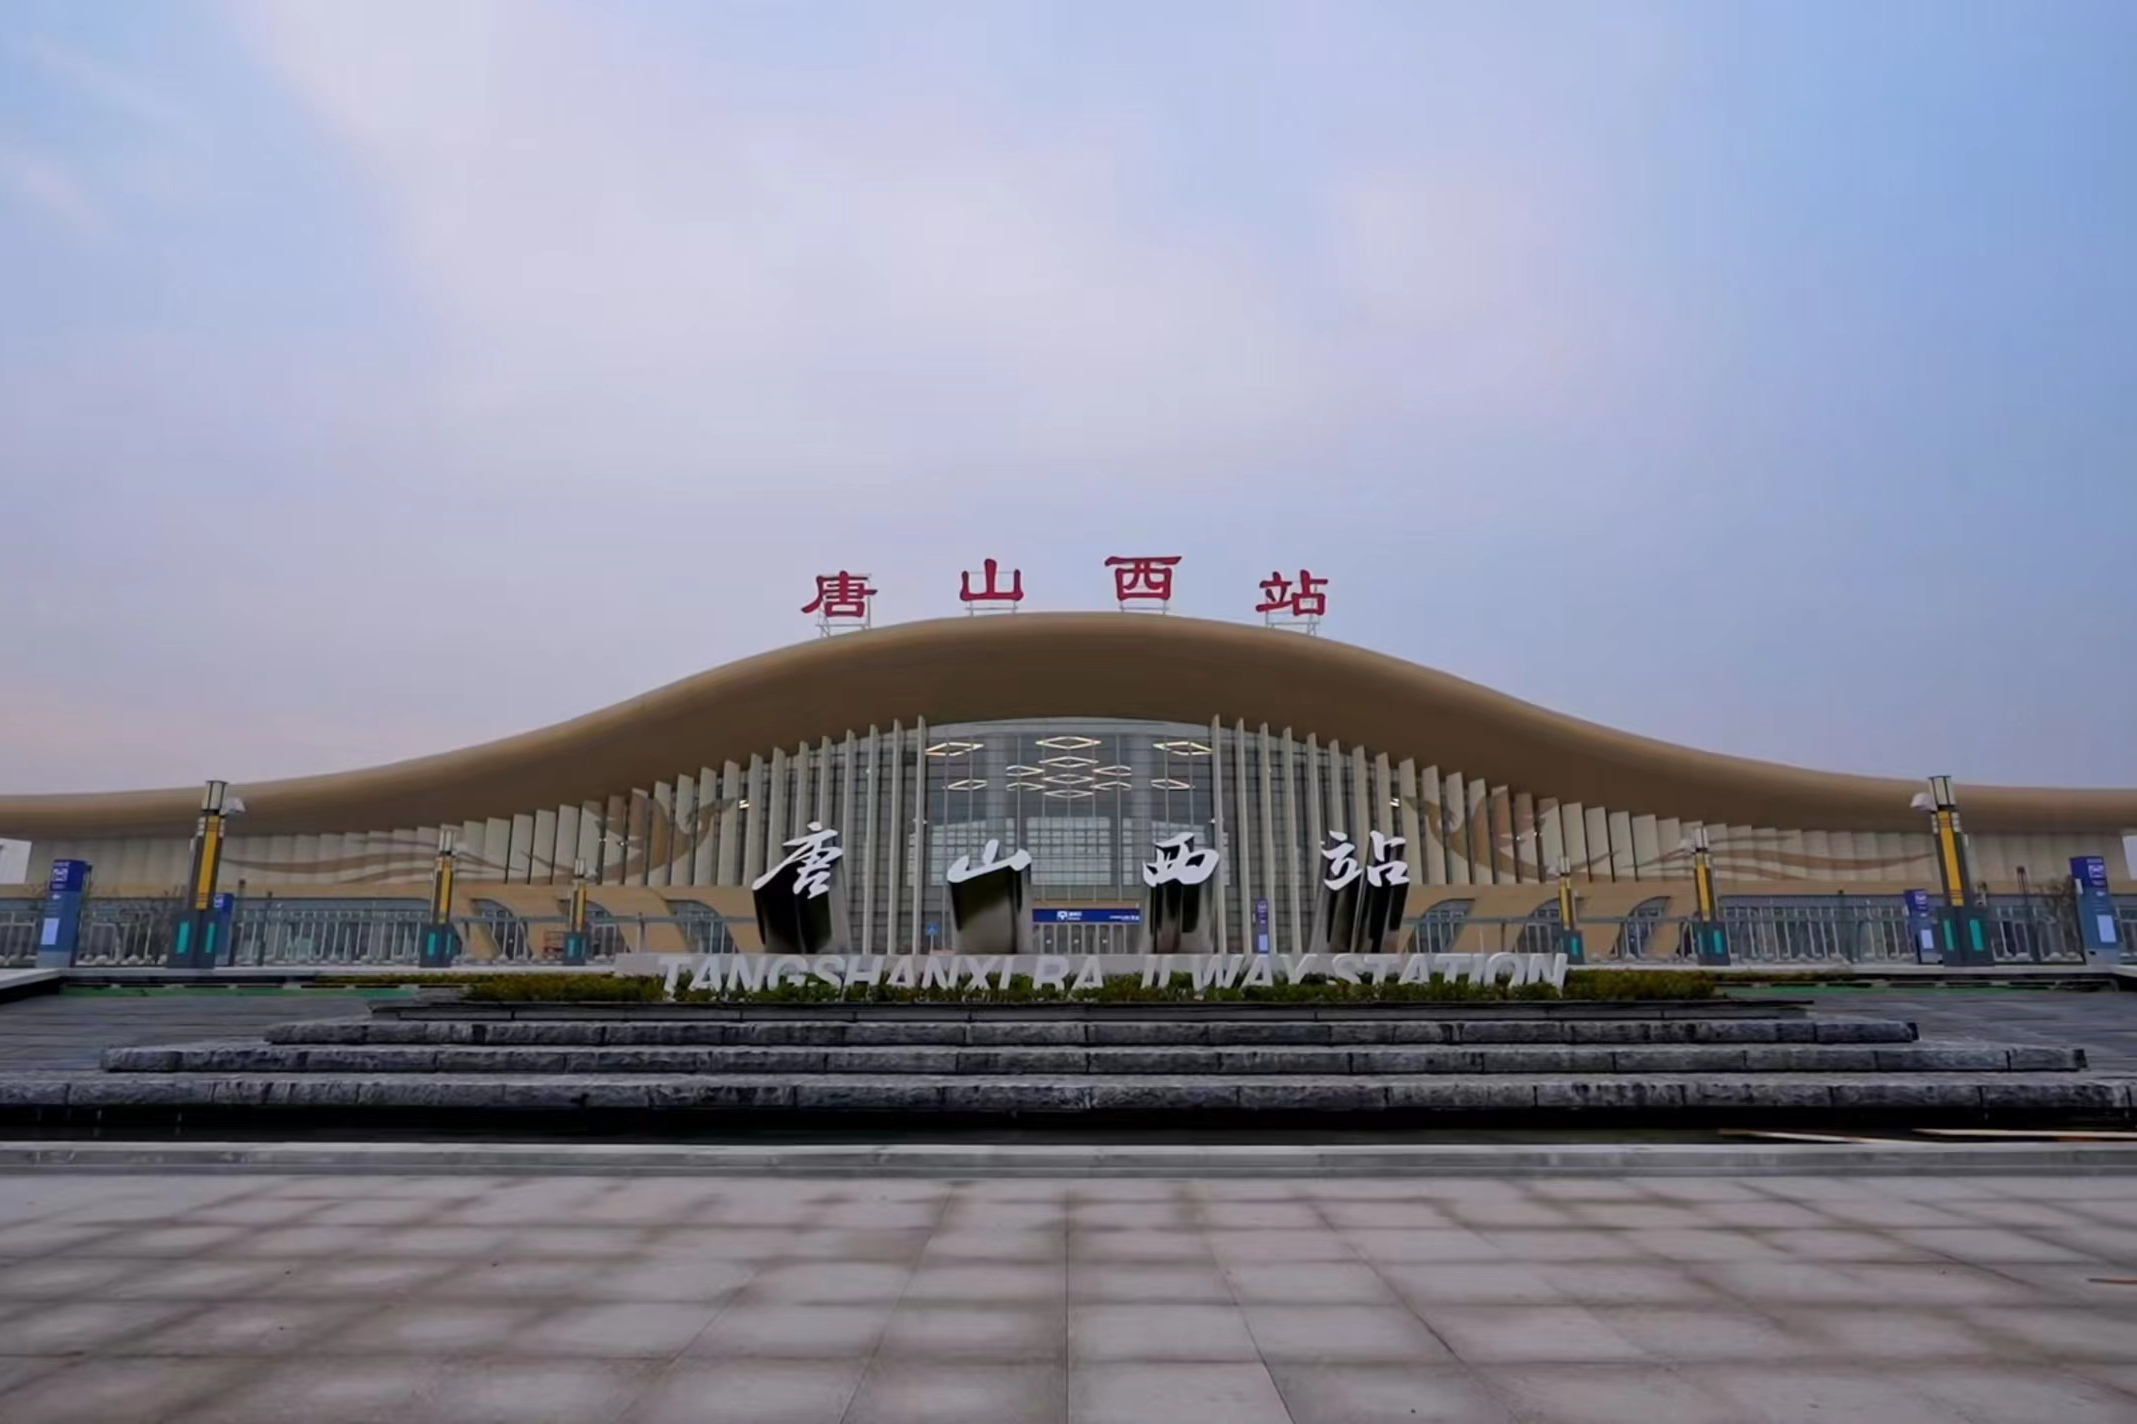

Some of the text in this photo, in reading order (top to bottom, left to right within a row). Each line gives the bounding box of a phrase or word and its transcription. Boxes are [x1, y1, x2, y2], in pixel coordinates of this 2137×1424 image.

[801, 555, 1328, 617] 唐山西站
[752, 822, 1410, 899] 唐山西站
[658, 955, 1015, 998] TANGSHANXI
[1331, 952, 1568, 997] STATION
